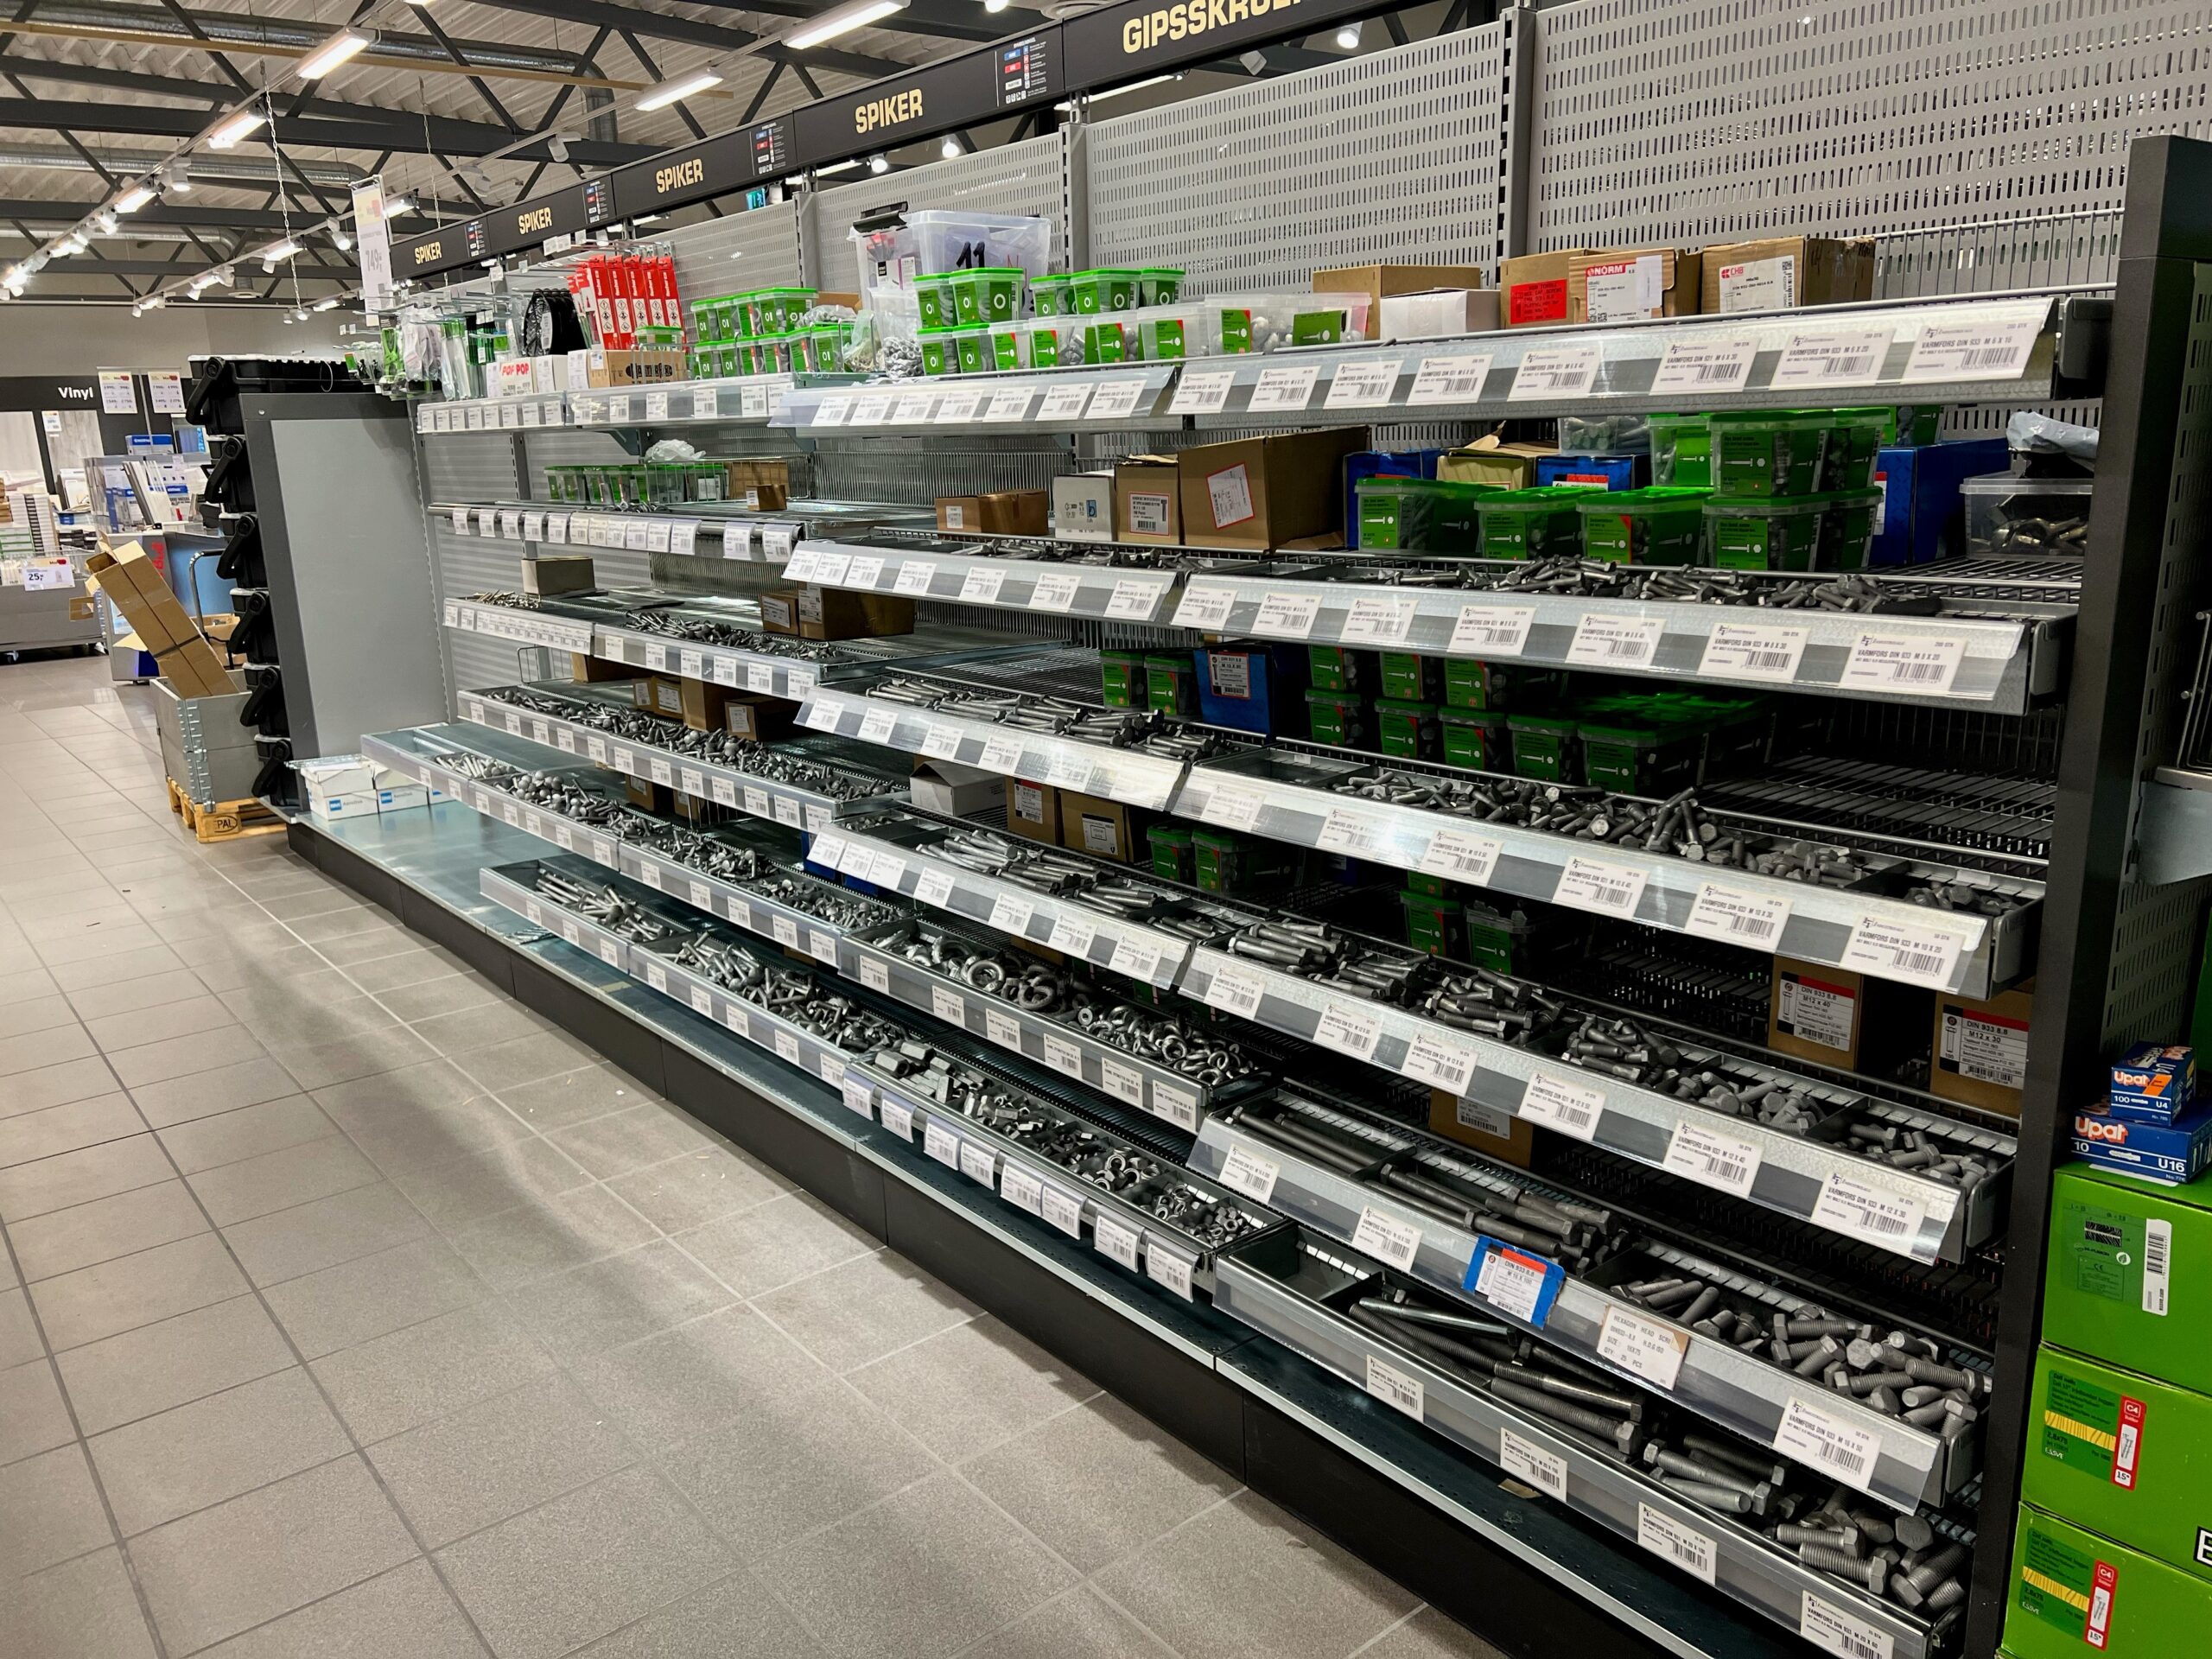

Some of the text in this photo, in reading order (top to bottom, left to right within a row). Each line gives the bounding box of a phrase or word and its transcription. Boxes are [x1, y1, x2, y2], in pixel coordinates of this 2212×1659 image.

[1123, 0, 1301, 54] GIPSSKR
[855, 88, 924, 134] SPIKER
[656, 158, 704, 194] SPIKER
[518, 207, 553, 235] SPIKER
[415, 242, 442, 264] SPIKER
[1920, 340, 1955, 348] VARMFORS
[516, 362, 530, 375] POP
[58, 387, 93, 400] Vinyl
[1856, 649, 1889, 658] VARMFORS
[1858, 931, 1889, 943] VARMFORS
[1801, 986, 1813, 995] DIN
[1802, 995, 1815, 1004] M12
[1967, 1020, 1980, 1029] DIN
[1981, 1024, 1994, 1033] 933
[1968, 1030, 1984, 1039] M12
[2113, 1071, 2151, 1087] Upat
[2075, 1116, 2128, 1144] Upat
[2075, 1141, 2185, 1172] 10 U16
[1827, 1186, 1856, 1202] VARMFORS
[1855, 1195, 1867, 1205] DIN
[1504, 1260, 1515, 1269] DIN
[1614, 1315, 1637, 1330] HEXAGON
[1640, 1326, 1655, 1337] HEAD
[1808, 1606, 1832, 1624] VARMFORS
[1834, 1620, 1842, 1630] DIN
